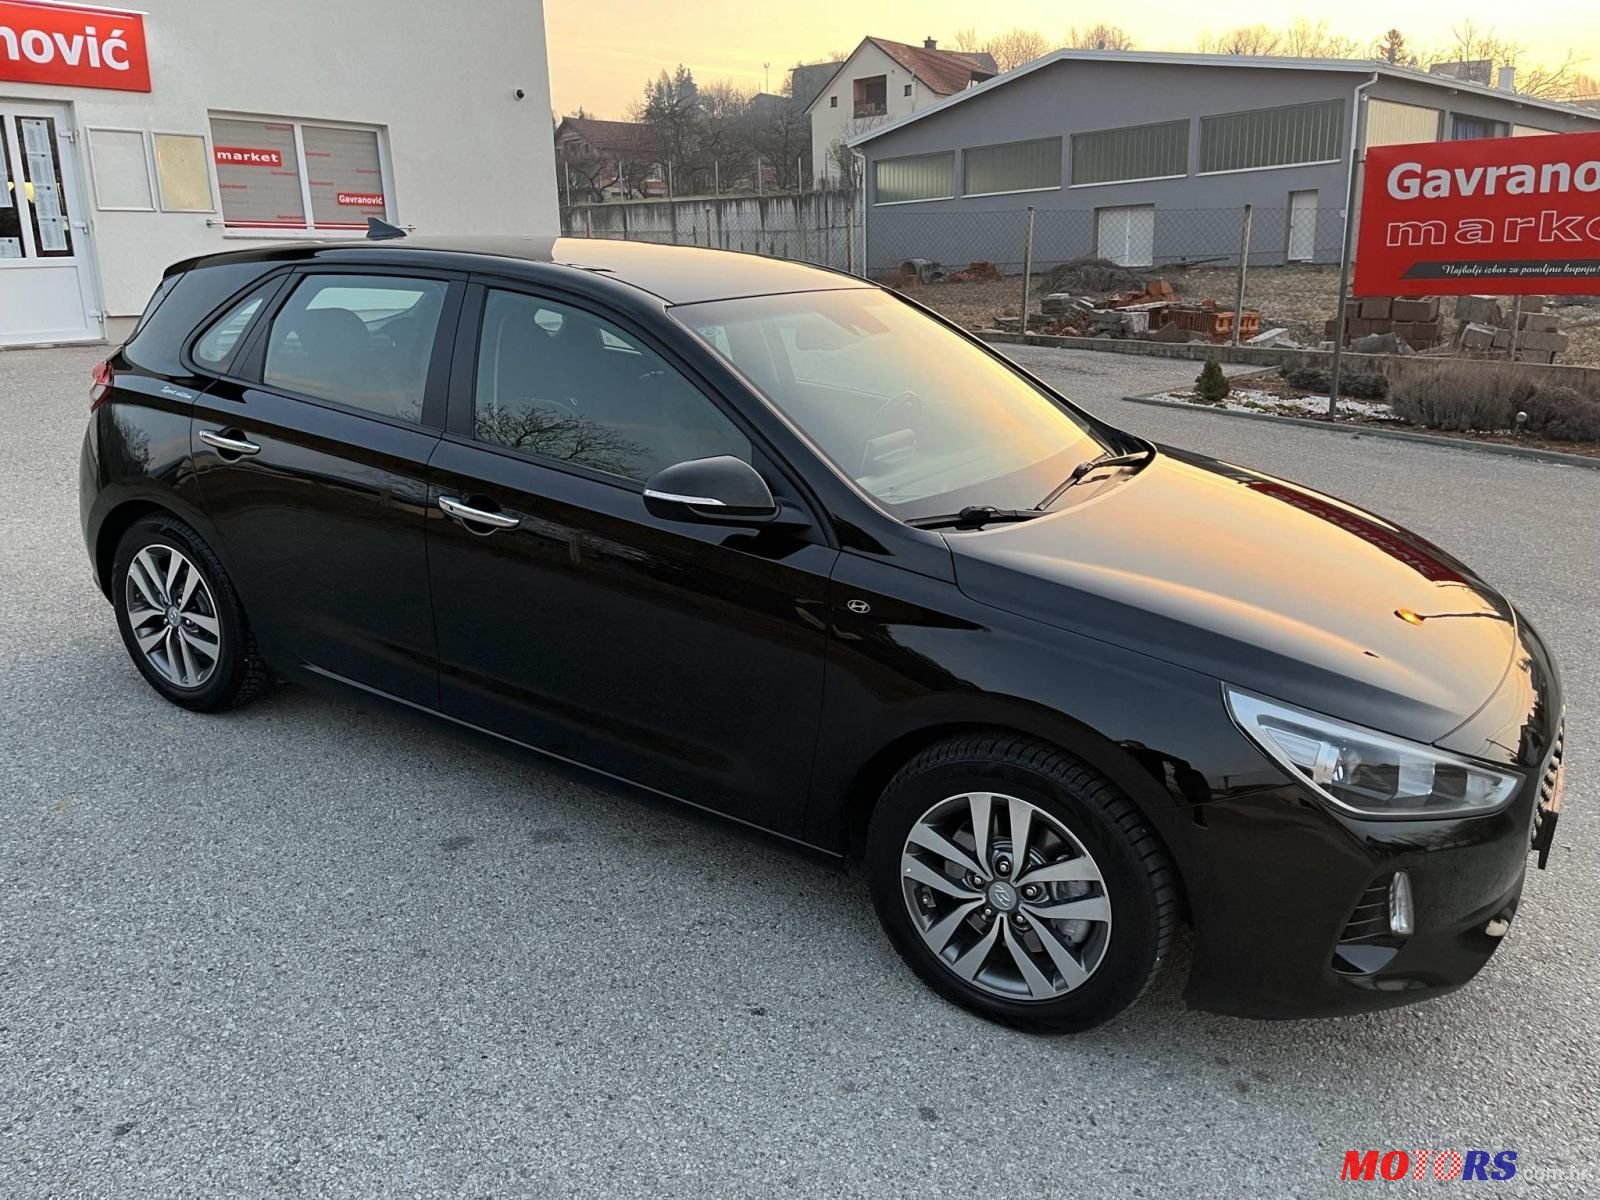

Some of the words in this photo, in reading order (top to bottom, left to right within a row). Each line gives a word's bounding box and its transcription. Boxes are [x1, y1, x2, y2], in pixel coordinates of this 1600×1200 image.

[0, 25, 130, 71] nović
[217, 151, 279, 163] market
[338, 194, 383, 205] Gavranović
[1442, 263, 1482, 277] Najbolji
[1484, 264, 1507, 274] izbor
[1520, 263, 1562, 276] povoljnu
